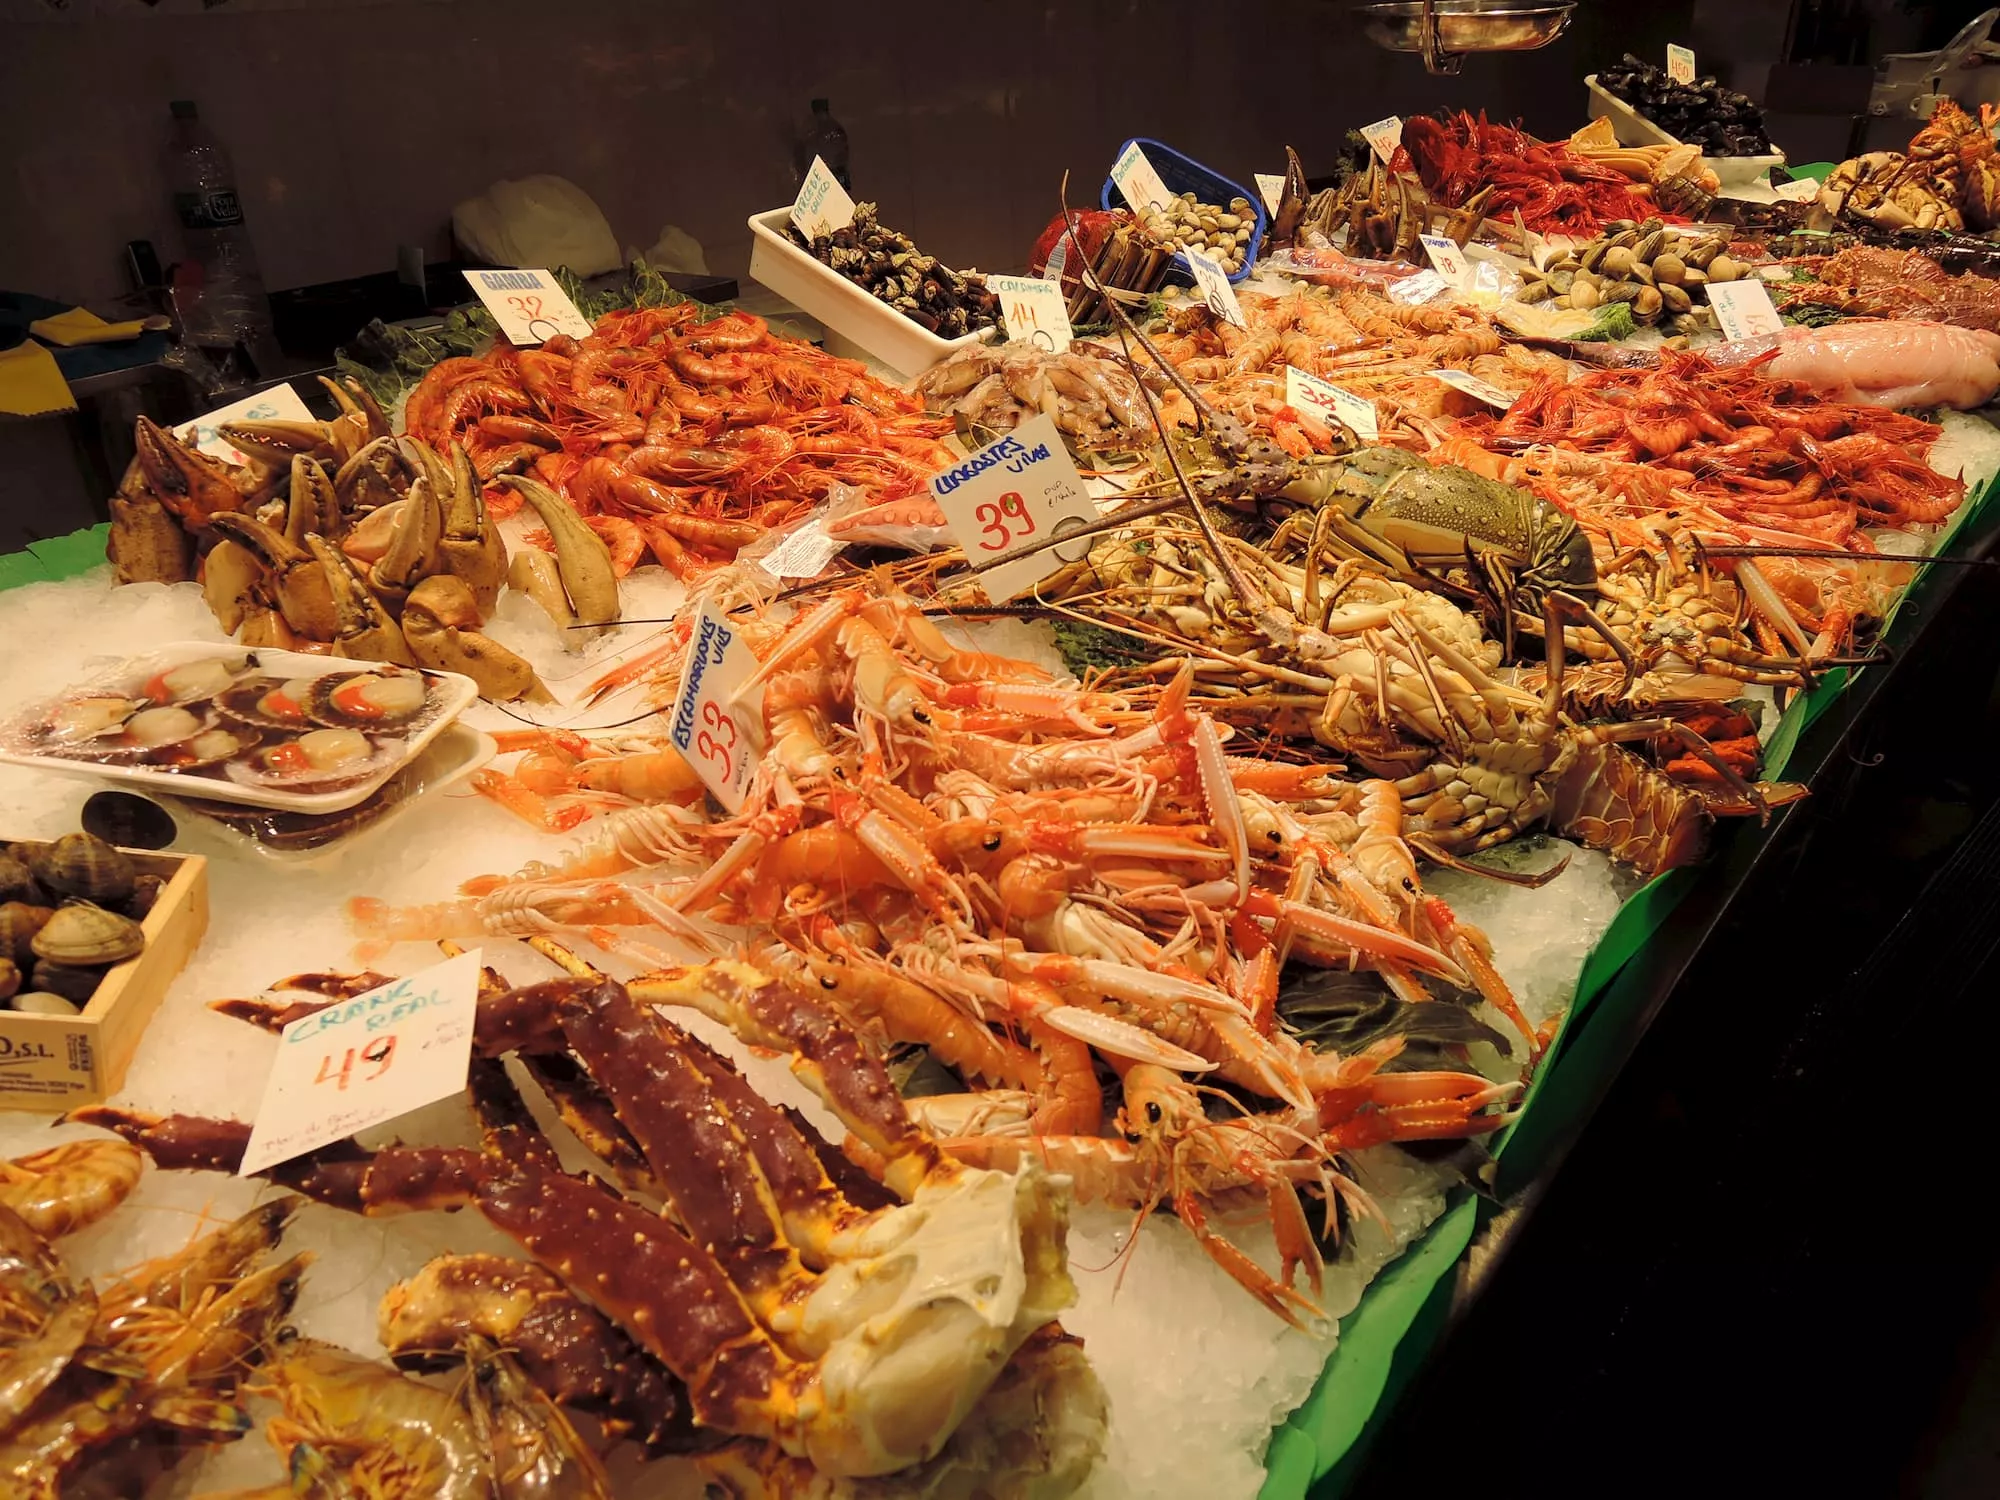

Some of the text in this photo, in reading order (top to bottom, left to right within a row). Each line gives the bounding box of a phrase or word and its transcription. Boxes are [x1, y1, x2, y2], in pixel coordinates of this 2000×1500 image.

[480, 272, 545, 291] GAMBA
[507, 296, 559, 321] 32
[1010, 302, 1038, 330] 14
[1298, 382, 1337, 411] 38
[975, 491, 1036, 551] 39
[697, 700, 736, 784] 33
[366, 989, 451, 1031] REAL
[314, 1035, 397, 1091] 49
